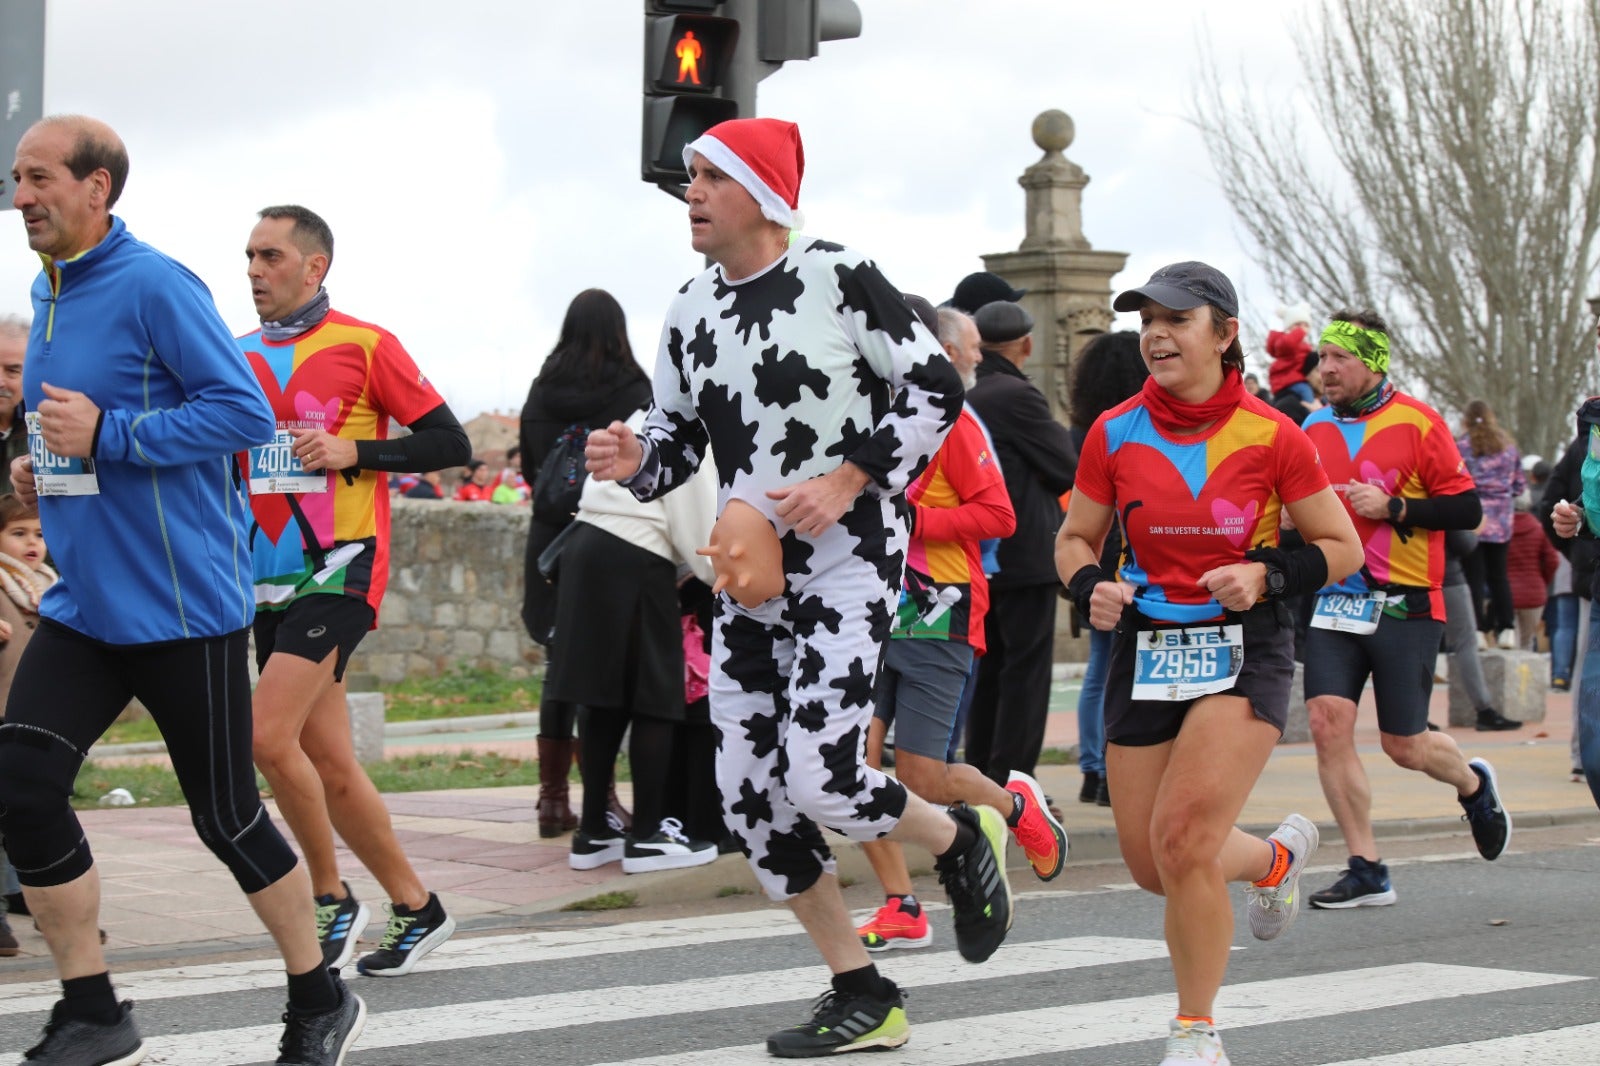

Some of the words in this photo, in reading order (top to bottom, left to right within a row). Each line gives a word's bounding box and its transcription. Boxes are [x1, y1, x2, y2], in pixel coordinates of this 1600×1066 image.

[1224, 517, 1244, 525] XXXIX
[1149, 526, 1163, 534] SAN
[1164, 526, 1200, 534] SILVESTRE
[1201, 526, 1244, 535] SALMANTINA
[1324, 595, 1366, 616] 3249
[1149, 648, 1216, 678] 2956
